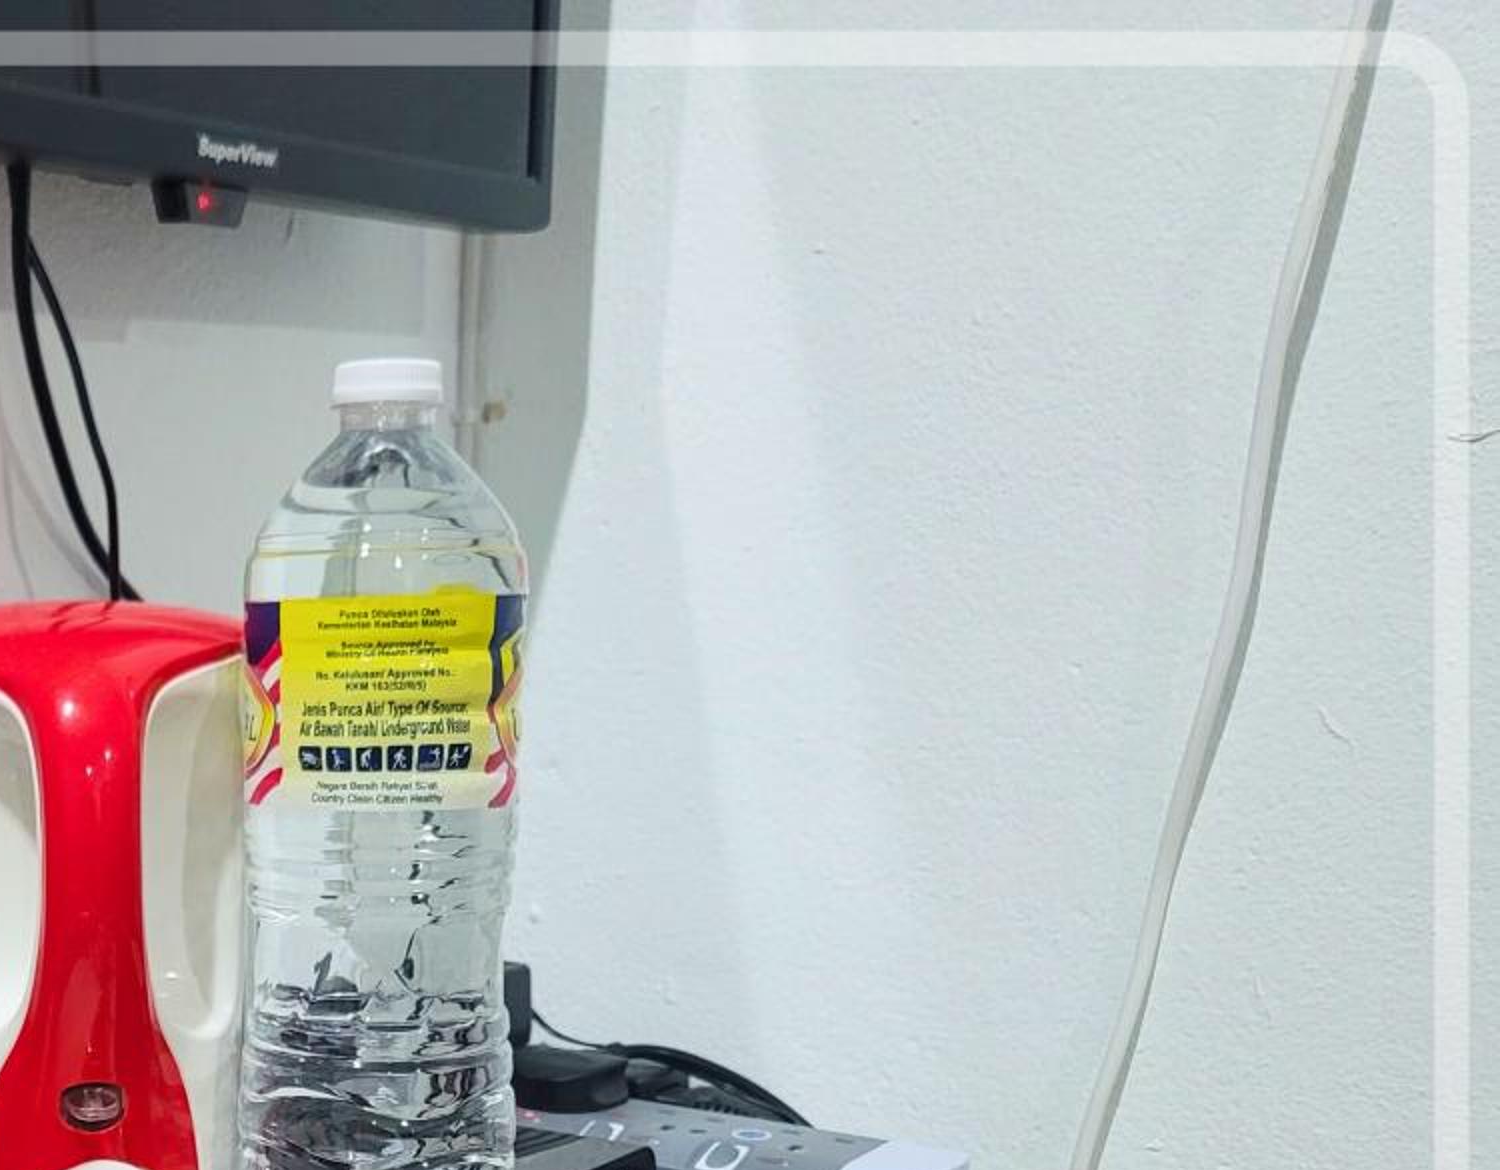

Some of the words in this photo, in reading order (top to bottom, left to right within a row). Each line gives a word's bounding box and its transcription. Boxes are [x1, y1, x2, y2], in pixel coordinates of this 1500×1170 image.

[421, 618, 457, 630] Malaysia
[387, 668, 435, 681] Approved
[302, 703, 327, 717] Jenis
[329, 702, 363, 717] Punca
[388, 701, 413, 719] Type
[313, 720, 344, 738] Bawah
